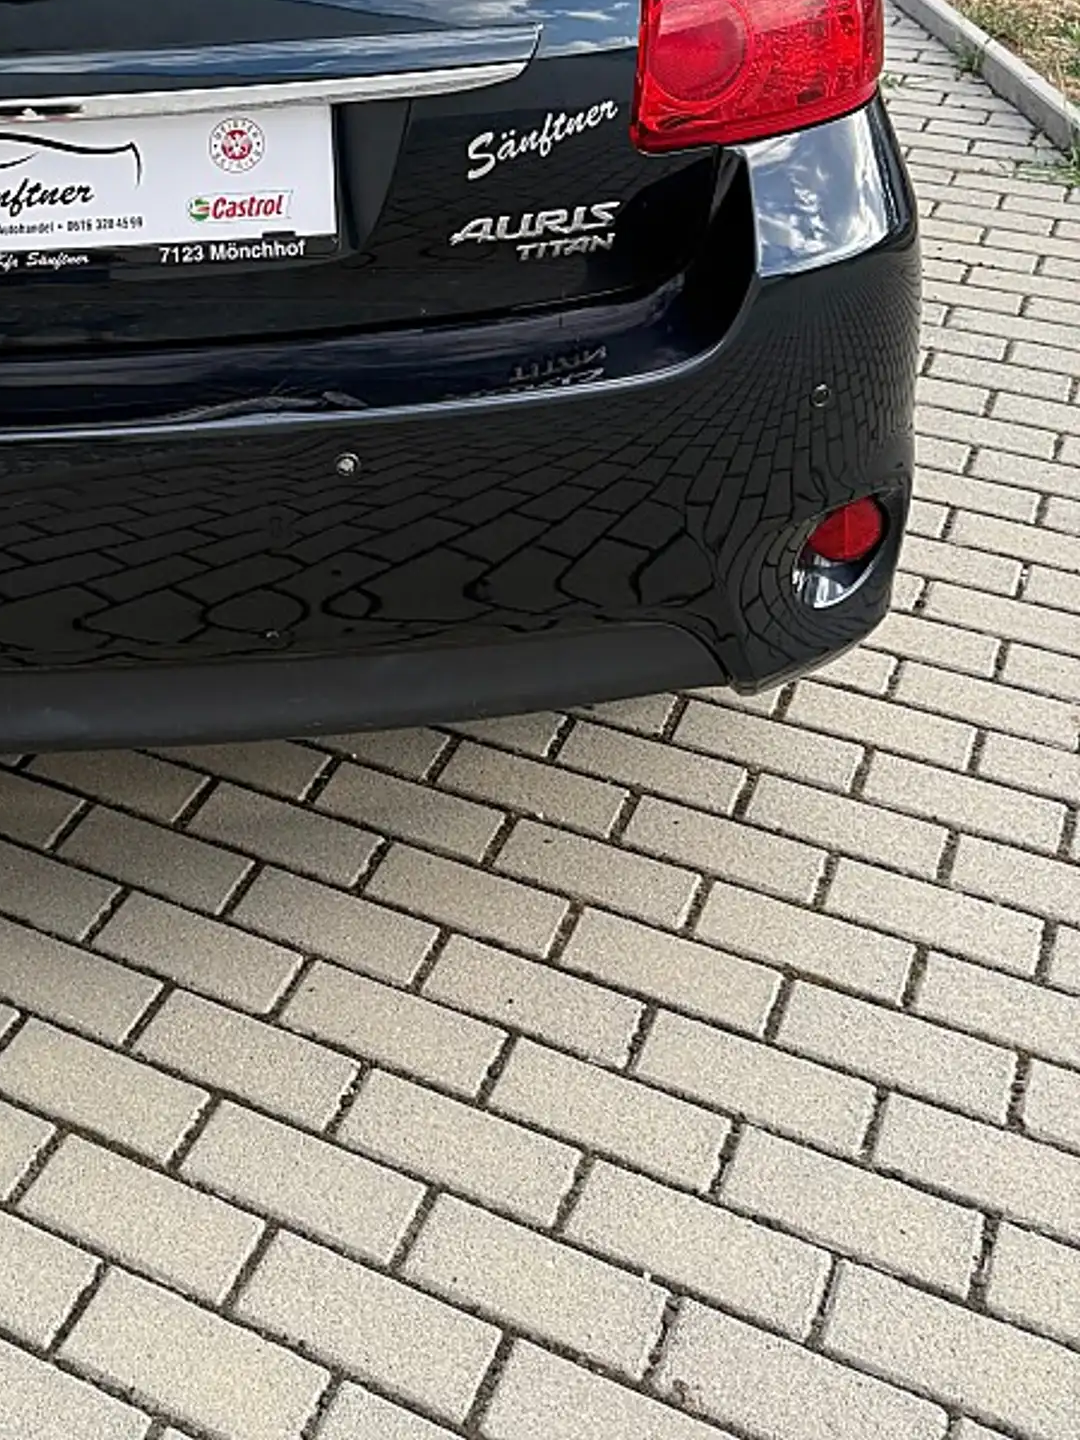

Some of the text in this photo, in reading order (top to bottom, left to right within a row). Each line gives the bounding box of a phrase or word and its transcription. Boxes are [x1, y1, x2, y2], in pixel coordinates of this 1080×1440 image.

[468, 100, 618, 180] Sänftner
[211, 195, 283, 219] Castrol
[449, 201, 620, 246] AURIS
[158, 239, 306, 264] 7123 Mönchhof
[516, 232, 615, 260] TITAN
